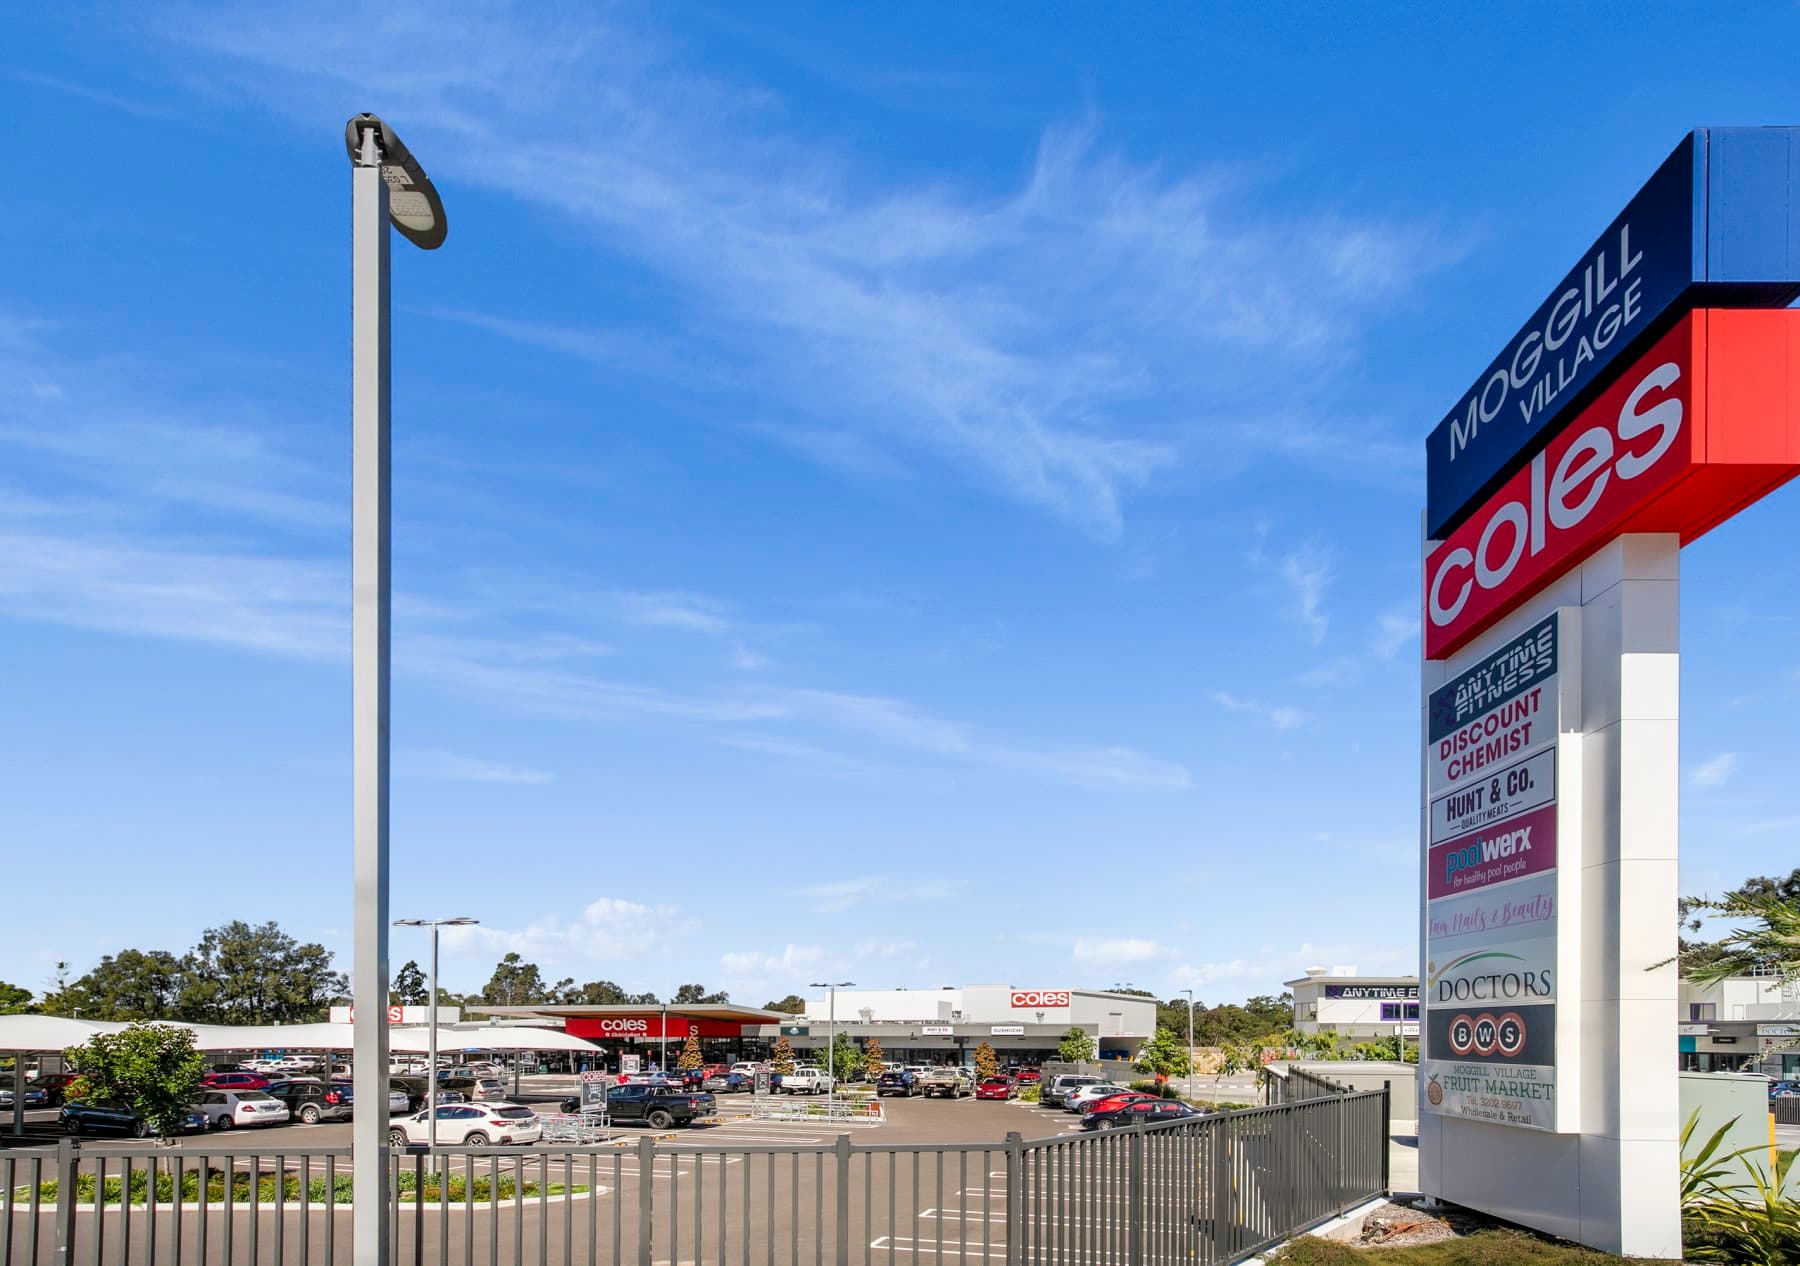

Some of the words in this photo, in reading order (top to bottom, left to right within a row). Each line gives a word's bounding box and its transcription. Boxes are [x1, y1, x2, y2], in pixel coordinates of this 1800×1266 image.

[1449, 223, 1644, 462] MOGGILL
[1518, 276, 1642, 425] VILLAGE
[1429, 361, 1684, 627] coles
[1454, 623, 1553, 707] ANYTIME
[1455, 648, 1553, 723] FITNESS
[1440, 687, 1541, 762] DISCOUNT
[1447, 721, 1533, 781] CHEMIST
[1446, 786, 1485, 822] HUNT
[1489, 778, 1502, 804] &
[1506, 767, 1534, 797] CO.
[1461, 809, 1487, 830] QUALITY
[1487, 802, 1509, 822] MEATS
[1446, 825, 1532, 884] poolwerx
[1453, 872, 1463, 889] for
[1463, 866, 1486, 885] healthy
[1487, 862, 1502, 882] pool
[1503, 858, 1527, 877] people
[1501, 893, 1554, 927] Beauty
[1012, 991, 1069, 1006] coles
[1342, 987, 1405, 997] ANYTIME
[1438, 969, 1551, 1002] DOCTORS
[601, 1018, 648, 1031] coles
[1443, 1075, 1481, 1093] FRUIT
[1485, 1080, 1555, 1100] MARKET
[1453, 1065, 1490, 1077] MOGGILL
[1494, 1067, 1537, 1080] VILLAGE
[1460, 1105, 1498, 1119] Wholesale
[1499, 1112, 1505, 1121] &
[1508, 1112, 1532, 1125] Retail
